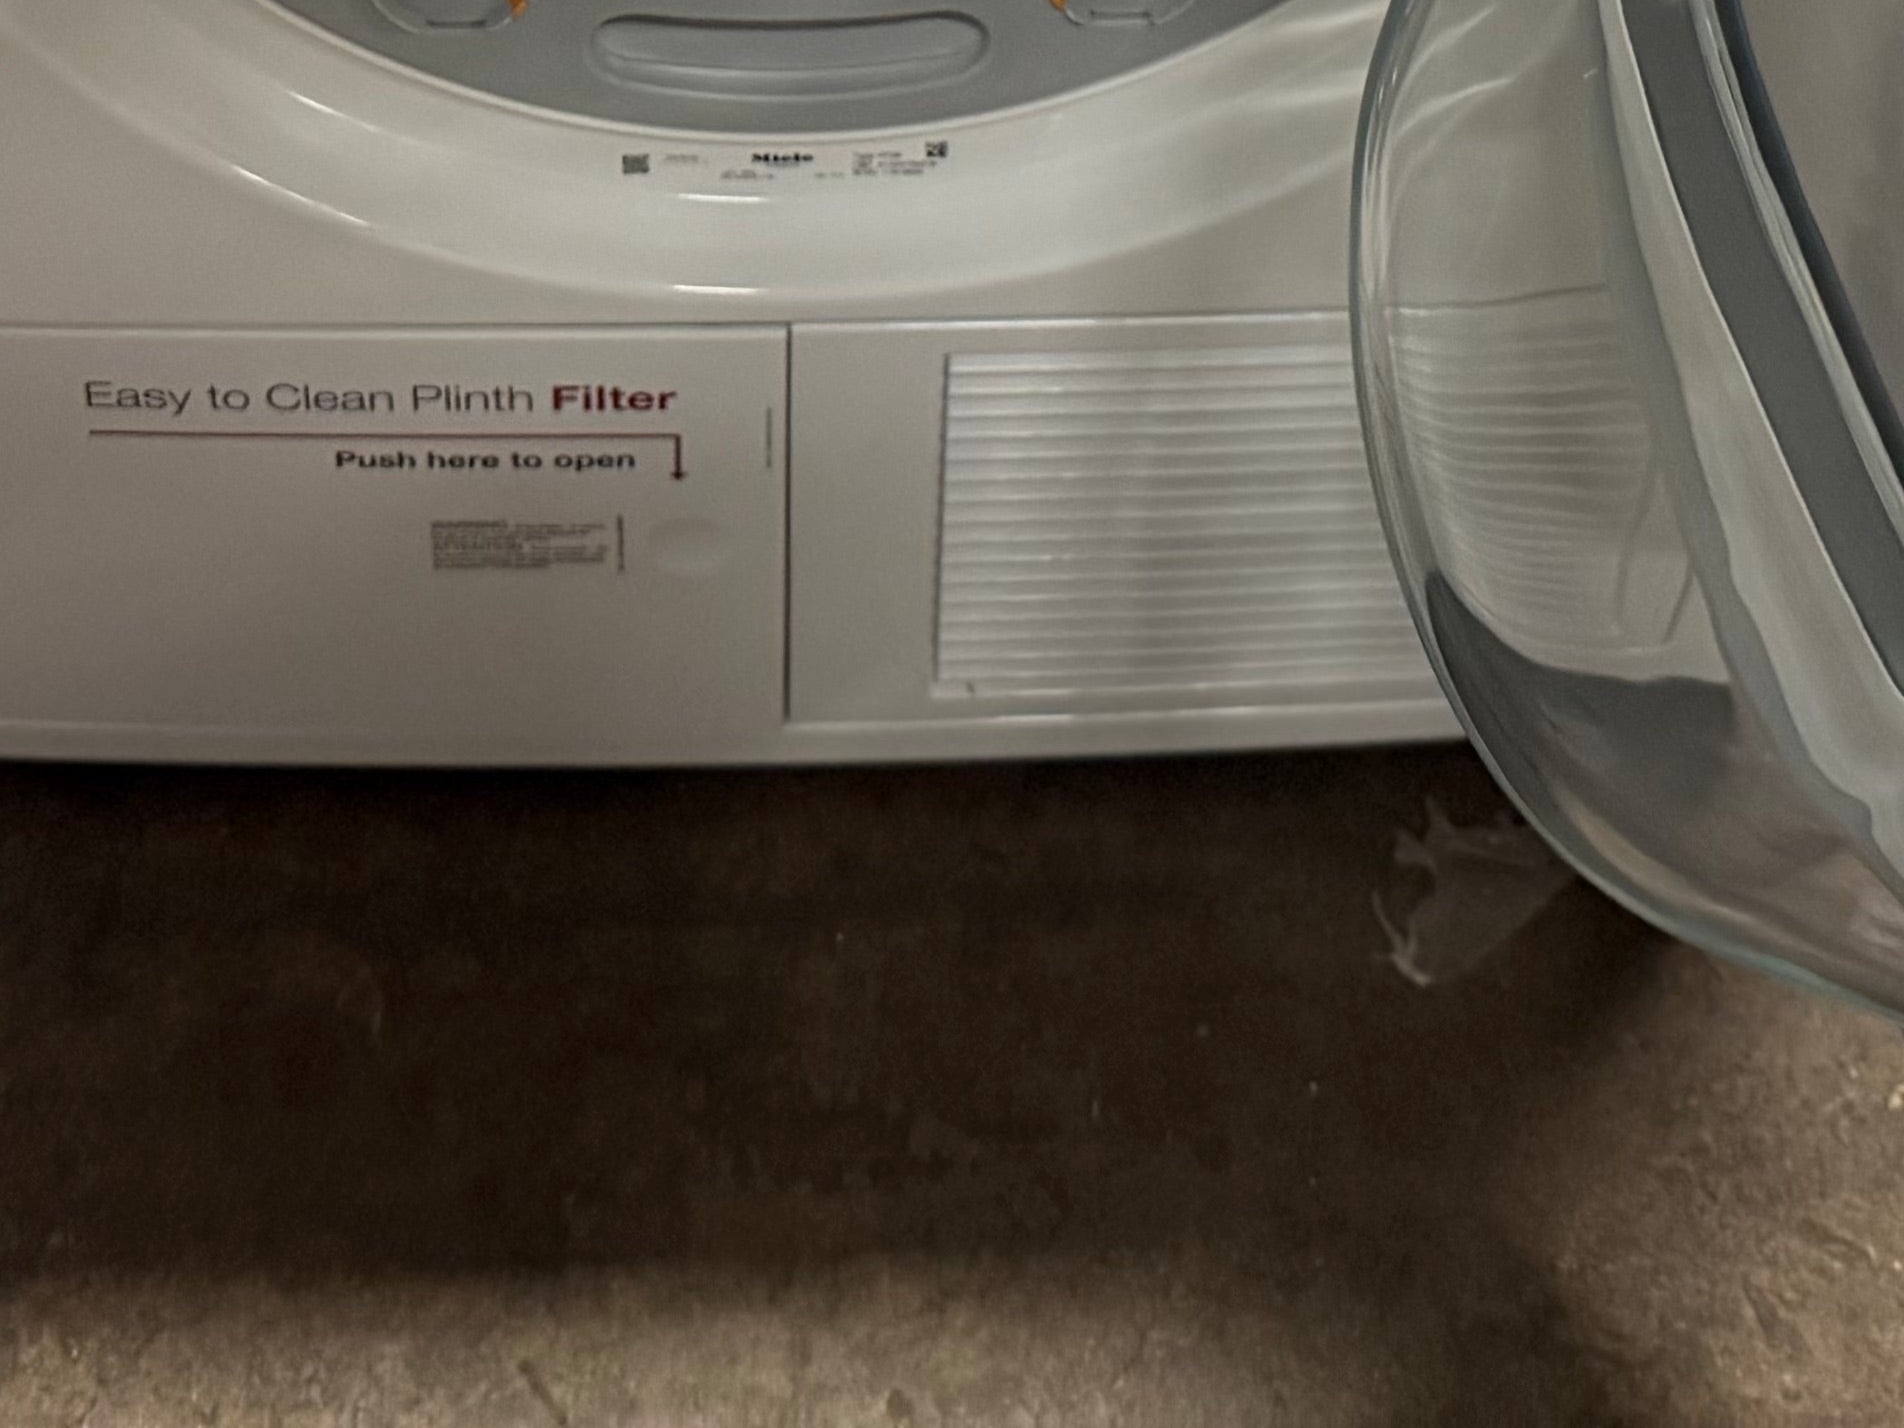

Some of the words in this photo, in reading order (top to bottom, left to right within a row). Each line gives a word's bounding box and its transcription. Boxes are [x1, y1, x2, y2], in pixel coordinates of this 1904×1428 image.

[84, 380, 191, 417] Easy
[207, 385, 251, 411] to
[265, 383, 395, 413] Clean
[412, 384, 534, 413] Plinth
[552, 385, 677, 412] Filter
[335, 450, 417, 469] Push
[427, 451, 500, 470] here
[511, 452, 543, 469] to
[553, 454, 636, 473] open
